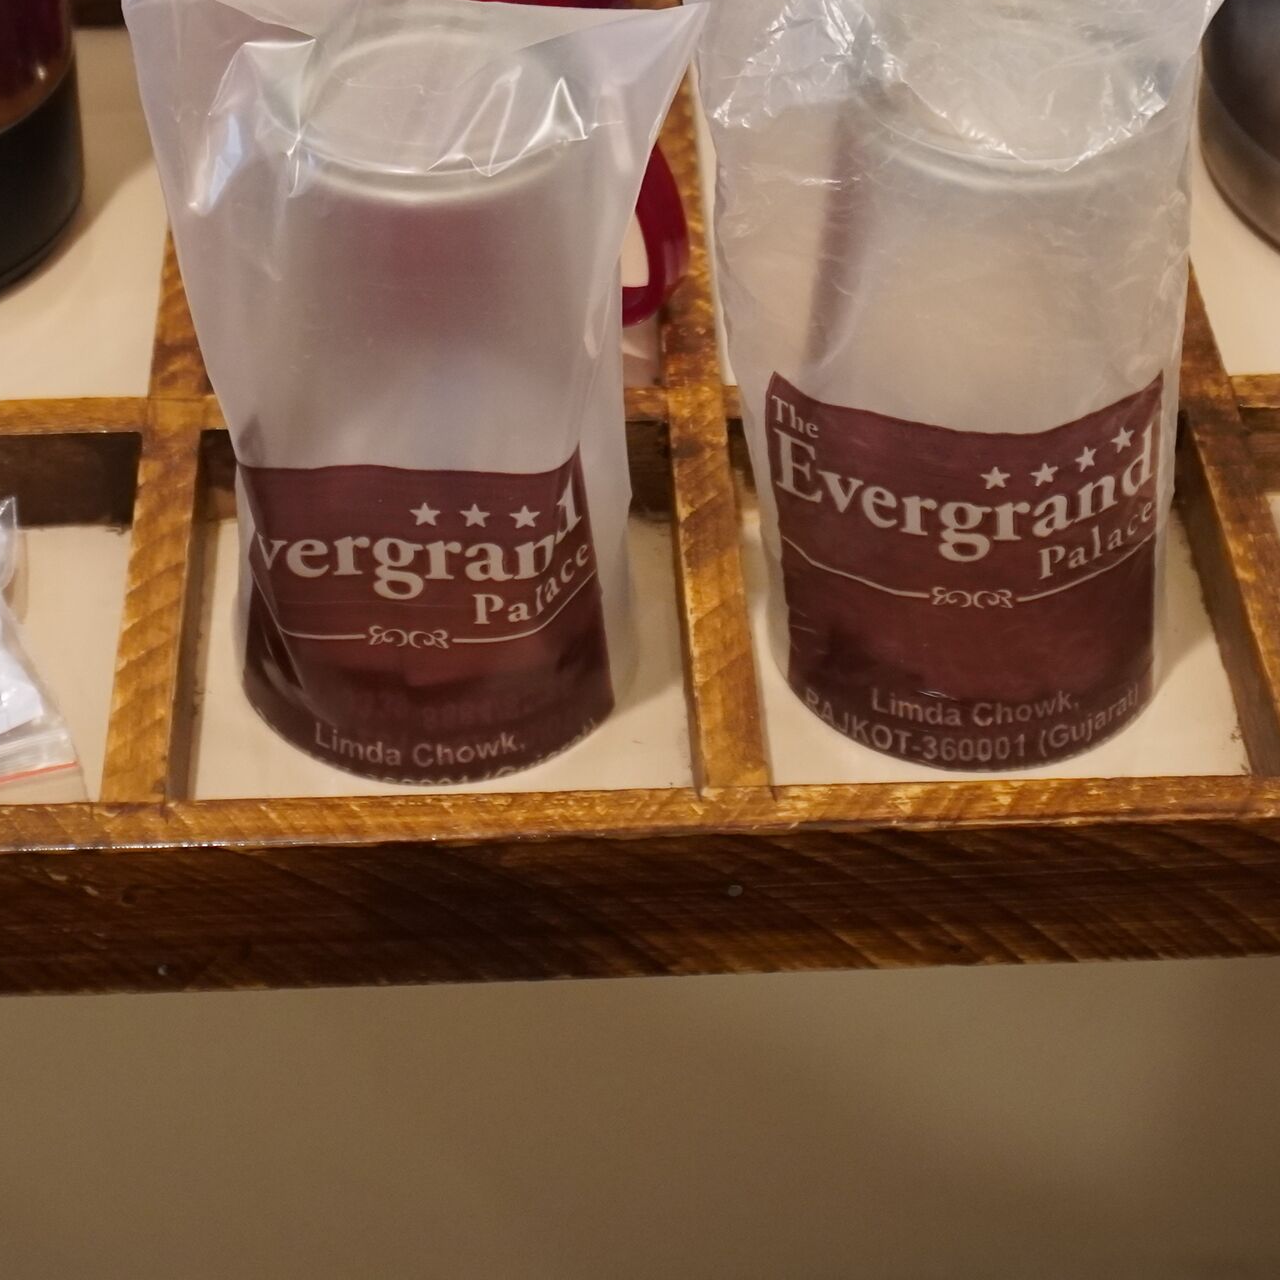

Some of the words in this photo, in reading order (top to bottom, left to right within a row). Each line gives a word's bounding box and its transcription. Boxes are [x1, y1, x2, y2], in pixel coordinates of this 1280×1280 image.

[771, 394, 820, 439] The
[773, 421, 1154, 563] Evergrand
[255, 475, 583, 600] vergrand
[1038, 500, 1153, 580] Palace
[472, 543, 590, 625] Palace
[314, 721, 402, 767] Limda
[412, 731, 526, 767] Chowk,
[803, 686, 1027, 762] RAJKOT-360001
[872, 687, 963, 726] Limda
[972, 689, 1080, 727] Chowk,
